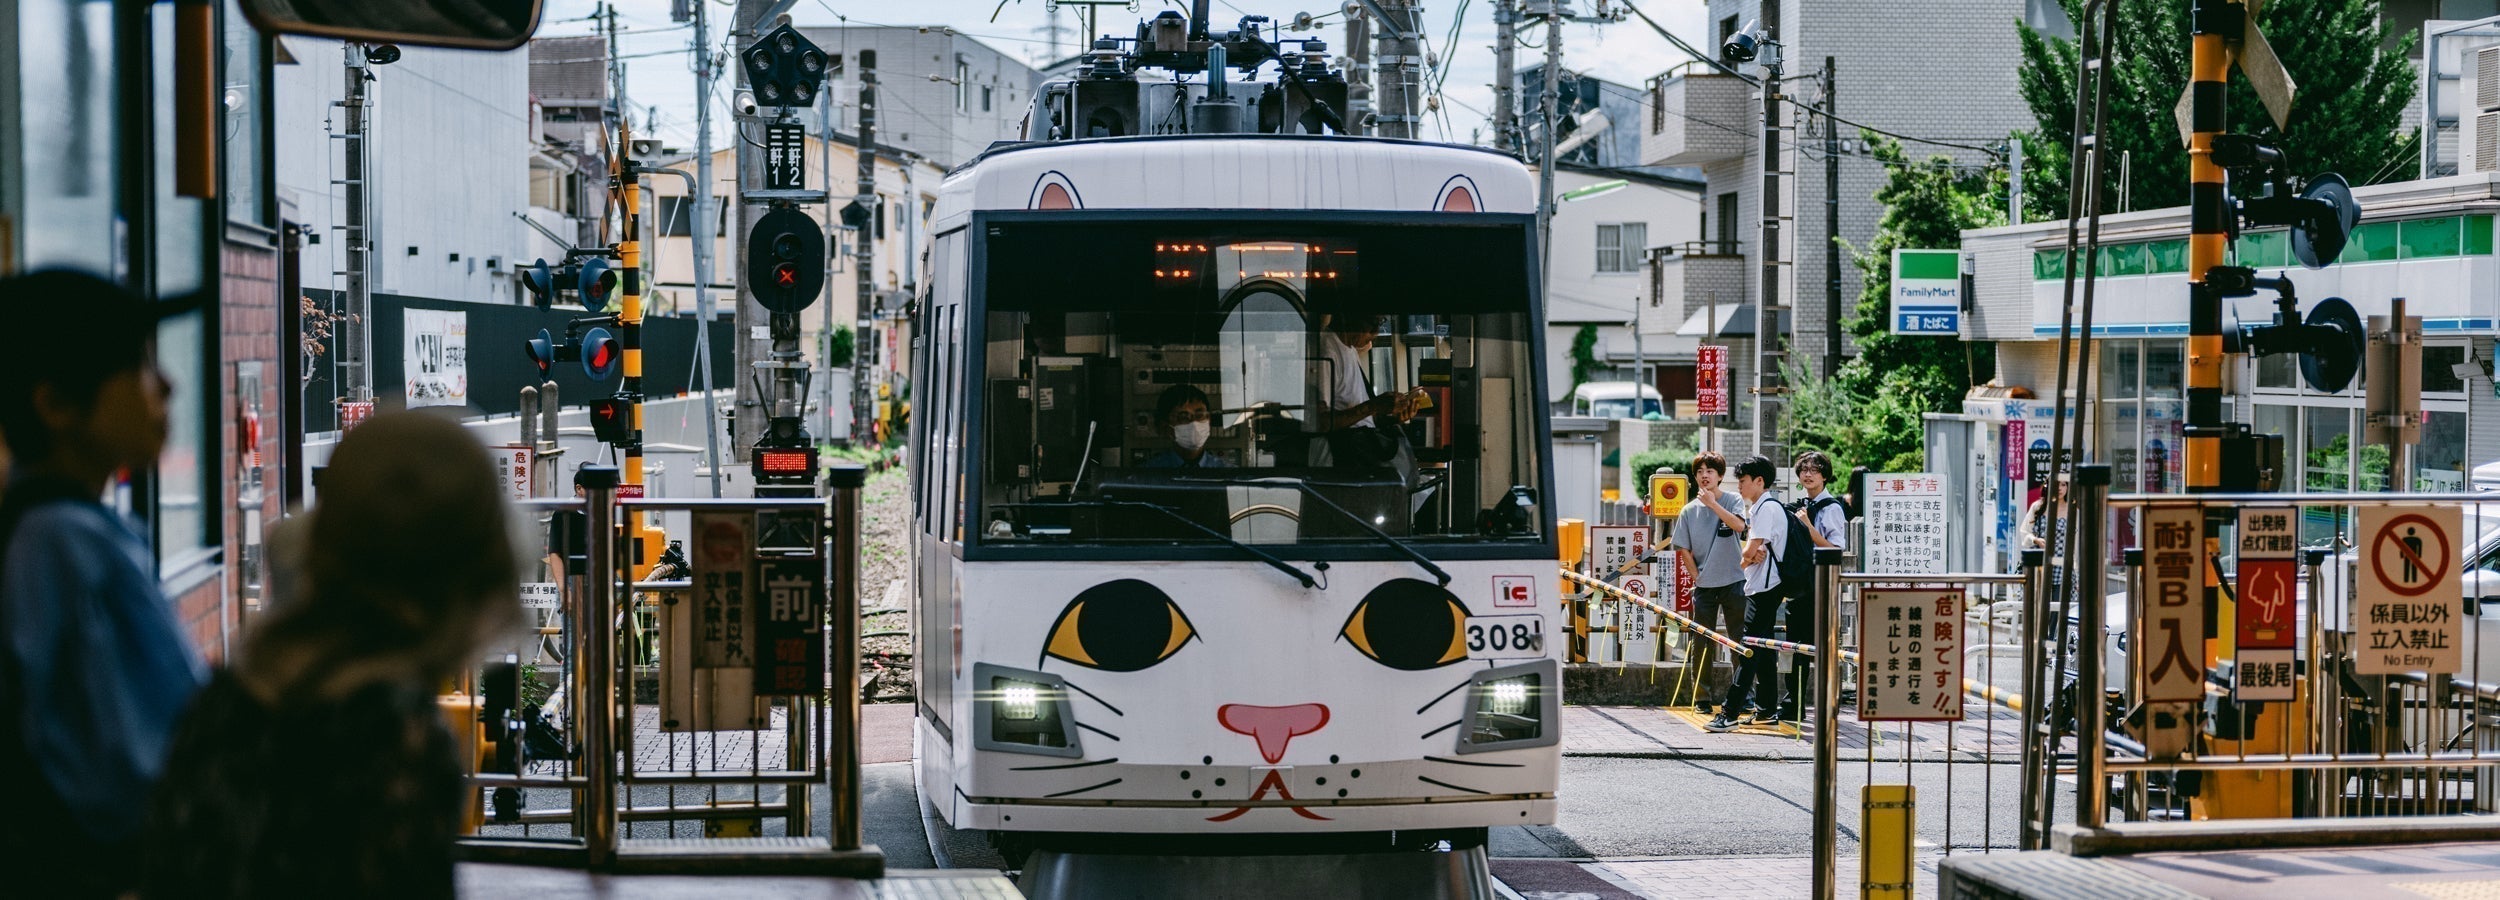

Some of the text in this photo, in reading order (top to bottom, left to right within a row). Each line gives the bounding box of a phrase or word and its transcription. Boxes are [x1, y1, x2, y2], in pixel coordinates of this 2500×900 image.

[1900, 287, 1956, 297] FamilyMart
[1906, 315, 1949, 330] 酒 たばこ
[1875, 480, 1939, 492] 工事予告
[2248, 514, 2287, 532] 出発時
[2242, 535, 2293, 552] 点灯確認
[1606, 536, 1614, 577] 禁止しま
[2370, 603, 2450, 625] 係員以外
[1887, 607, 1902, 688] 禁止します
[2369, 629, 2450, 650] 立入禁止
[1908, 607, 1922, 705] 線路の通行を
[2384, 655, 2435, 668] No Entry
[2240, 662, 2291, 687] 最後尾
[1868, 662, 1878, 711] 東急電鉄
